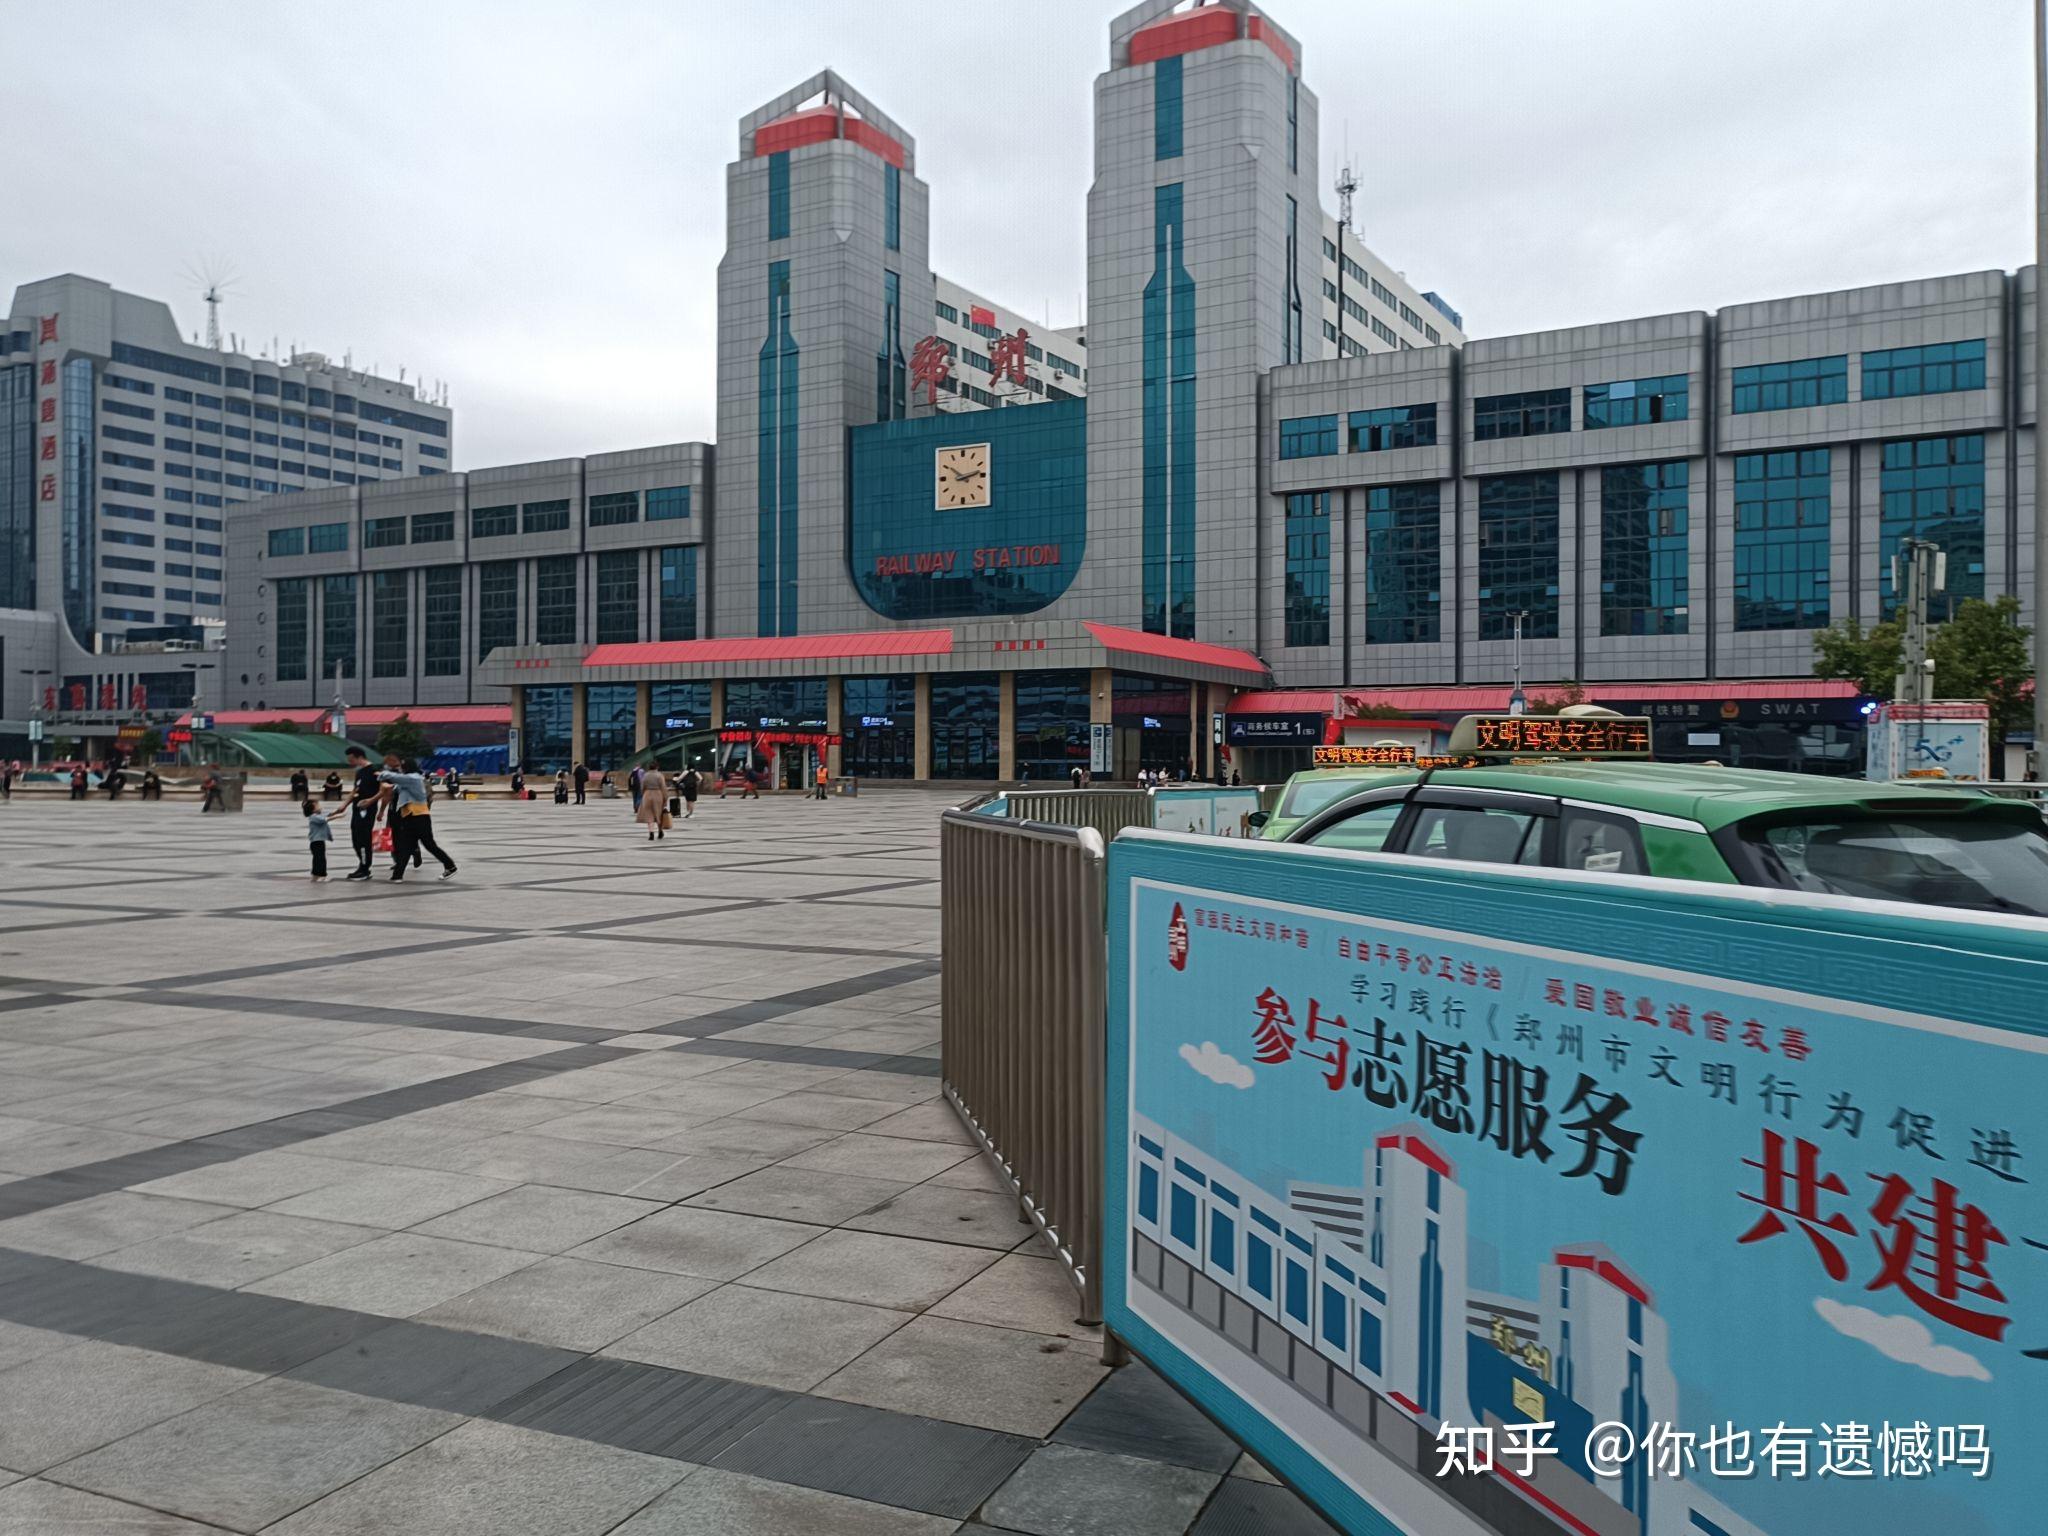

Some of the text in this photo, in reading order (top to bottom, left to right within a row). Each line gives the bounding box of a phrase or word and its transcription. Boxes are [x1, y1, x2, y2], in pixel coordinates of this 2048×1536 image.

[877, 545, 1059, 576] RAILWAY STATION
[1760, 703, 1821, 715] SWAT
[1476, 720, 1649, 751] 文明驾驶安全行车
[1315, 746, 1414, 764] 文明驾驶安全行车
[1194, 908, 1309, 949] 富强民主文明和谐
[1338, 936, 1503, 991] 自由平等公正法治
[1544, 977, 1813, 1062] 爱国敬业诚信友善
[1350, 974, 2029, 1183] 学习践行《郑州市文明行为促进
[1251, 986, 2048, 1361] 参与志愿服务 共建
